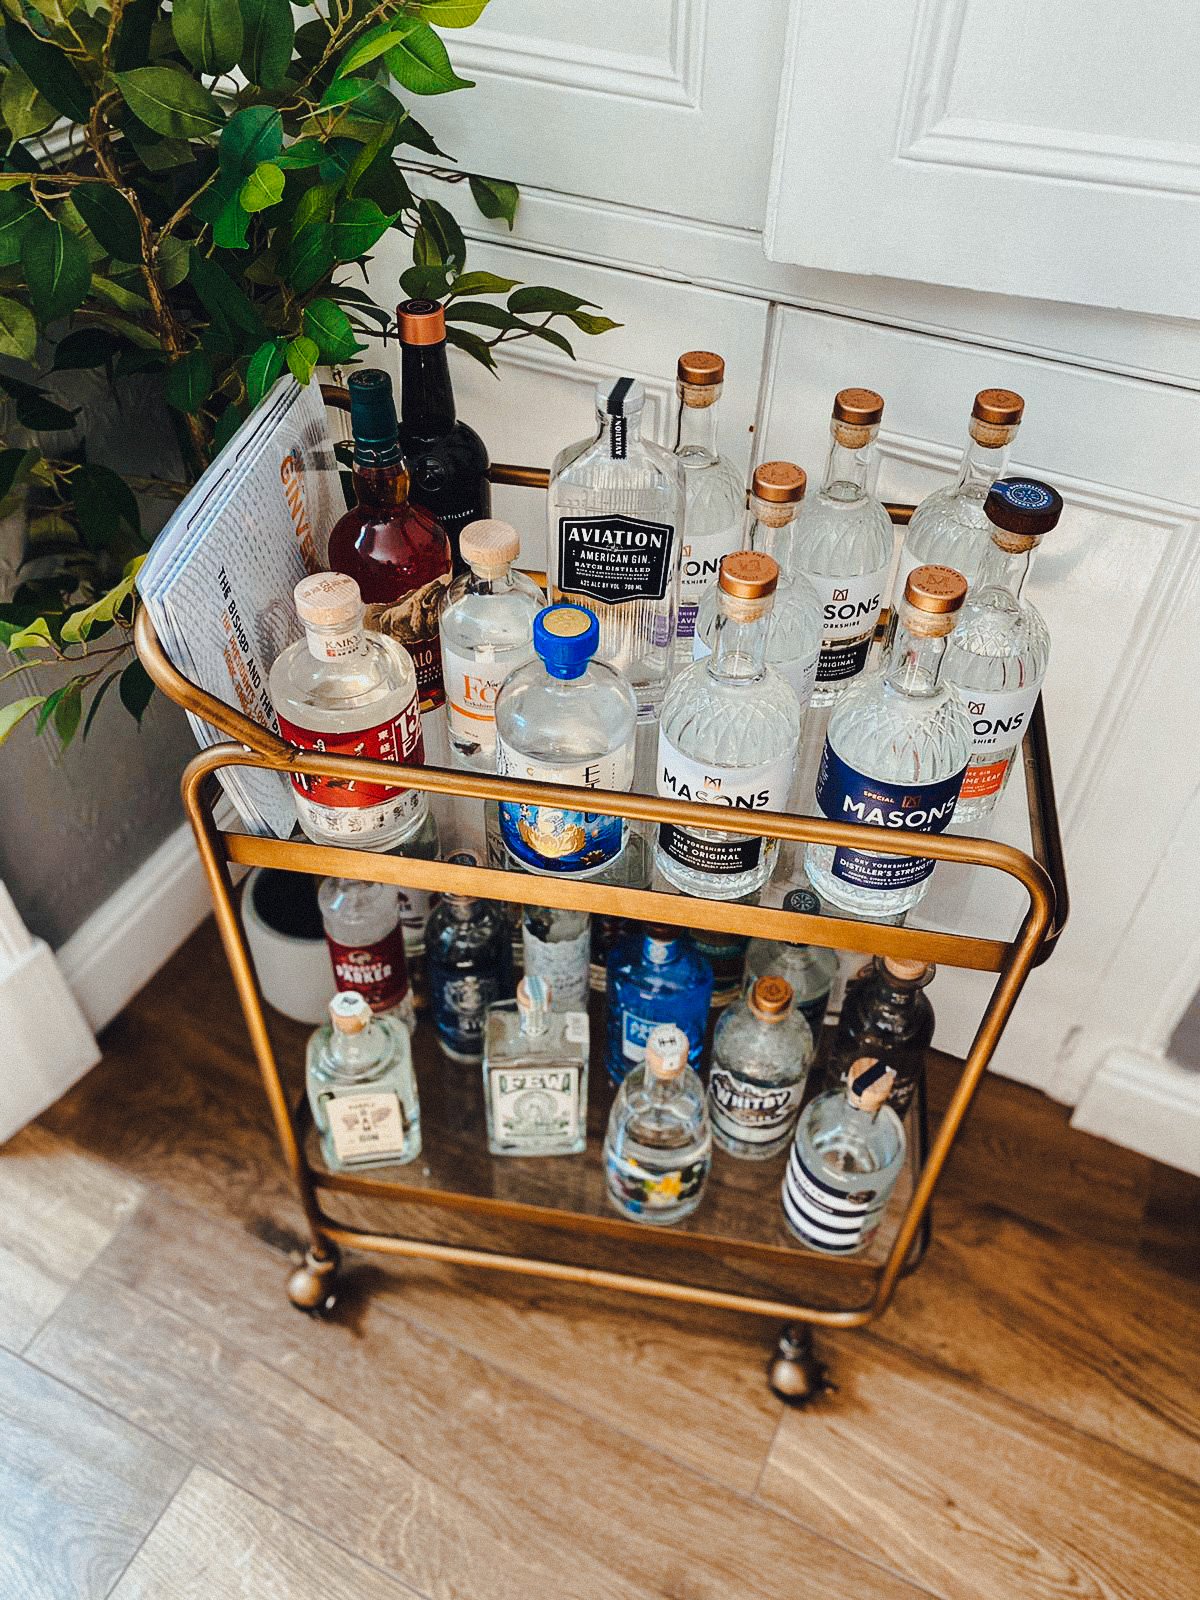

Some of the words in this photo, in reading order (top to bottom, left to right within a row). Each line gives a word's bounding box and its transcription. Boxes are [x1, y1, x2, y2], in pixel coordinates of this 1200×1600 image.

[568, 527, 662, 549] AVIATION
[574, 561, 603, 570] BATCH
[605, 565, 651, 573] DISTILLED
[580, 550, 629, 564] AMERICAN
[823, 593, 880, 620] SONS
[217, 566, 232, 600] THE
[227, 599, 249, 653] BISHOP
[246, 657, 262, 689] AND
[260, 687, 273, 719] THE
[863, 790, 895, 804] SPECIAL
[842, 794, 956, 828] MASONS
[673, 838, 688, 852] THE
[691, 849, 740, 861] ORIGINAL
[686, 839, 726, 853] YORKSHIRE
[839, 858, 893, 877] DISTILLER'S
[854, 857, 869, 866] DRY
[714, 1079, 790, 1111] WHITBY
